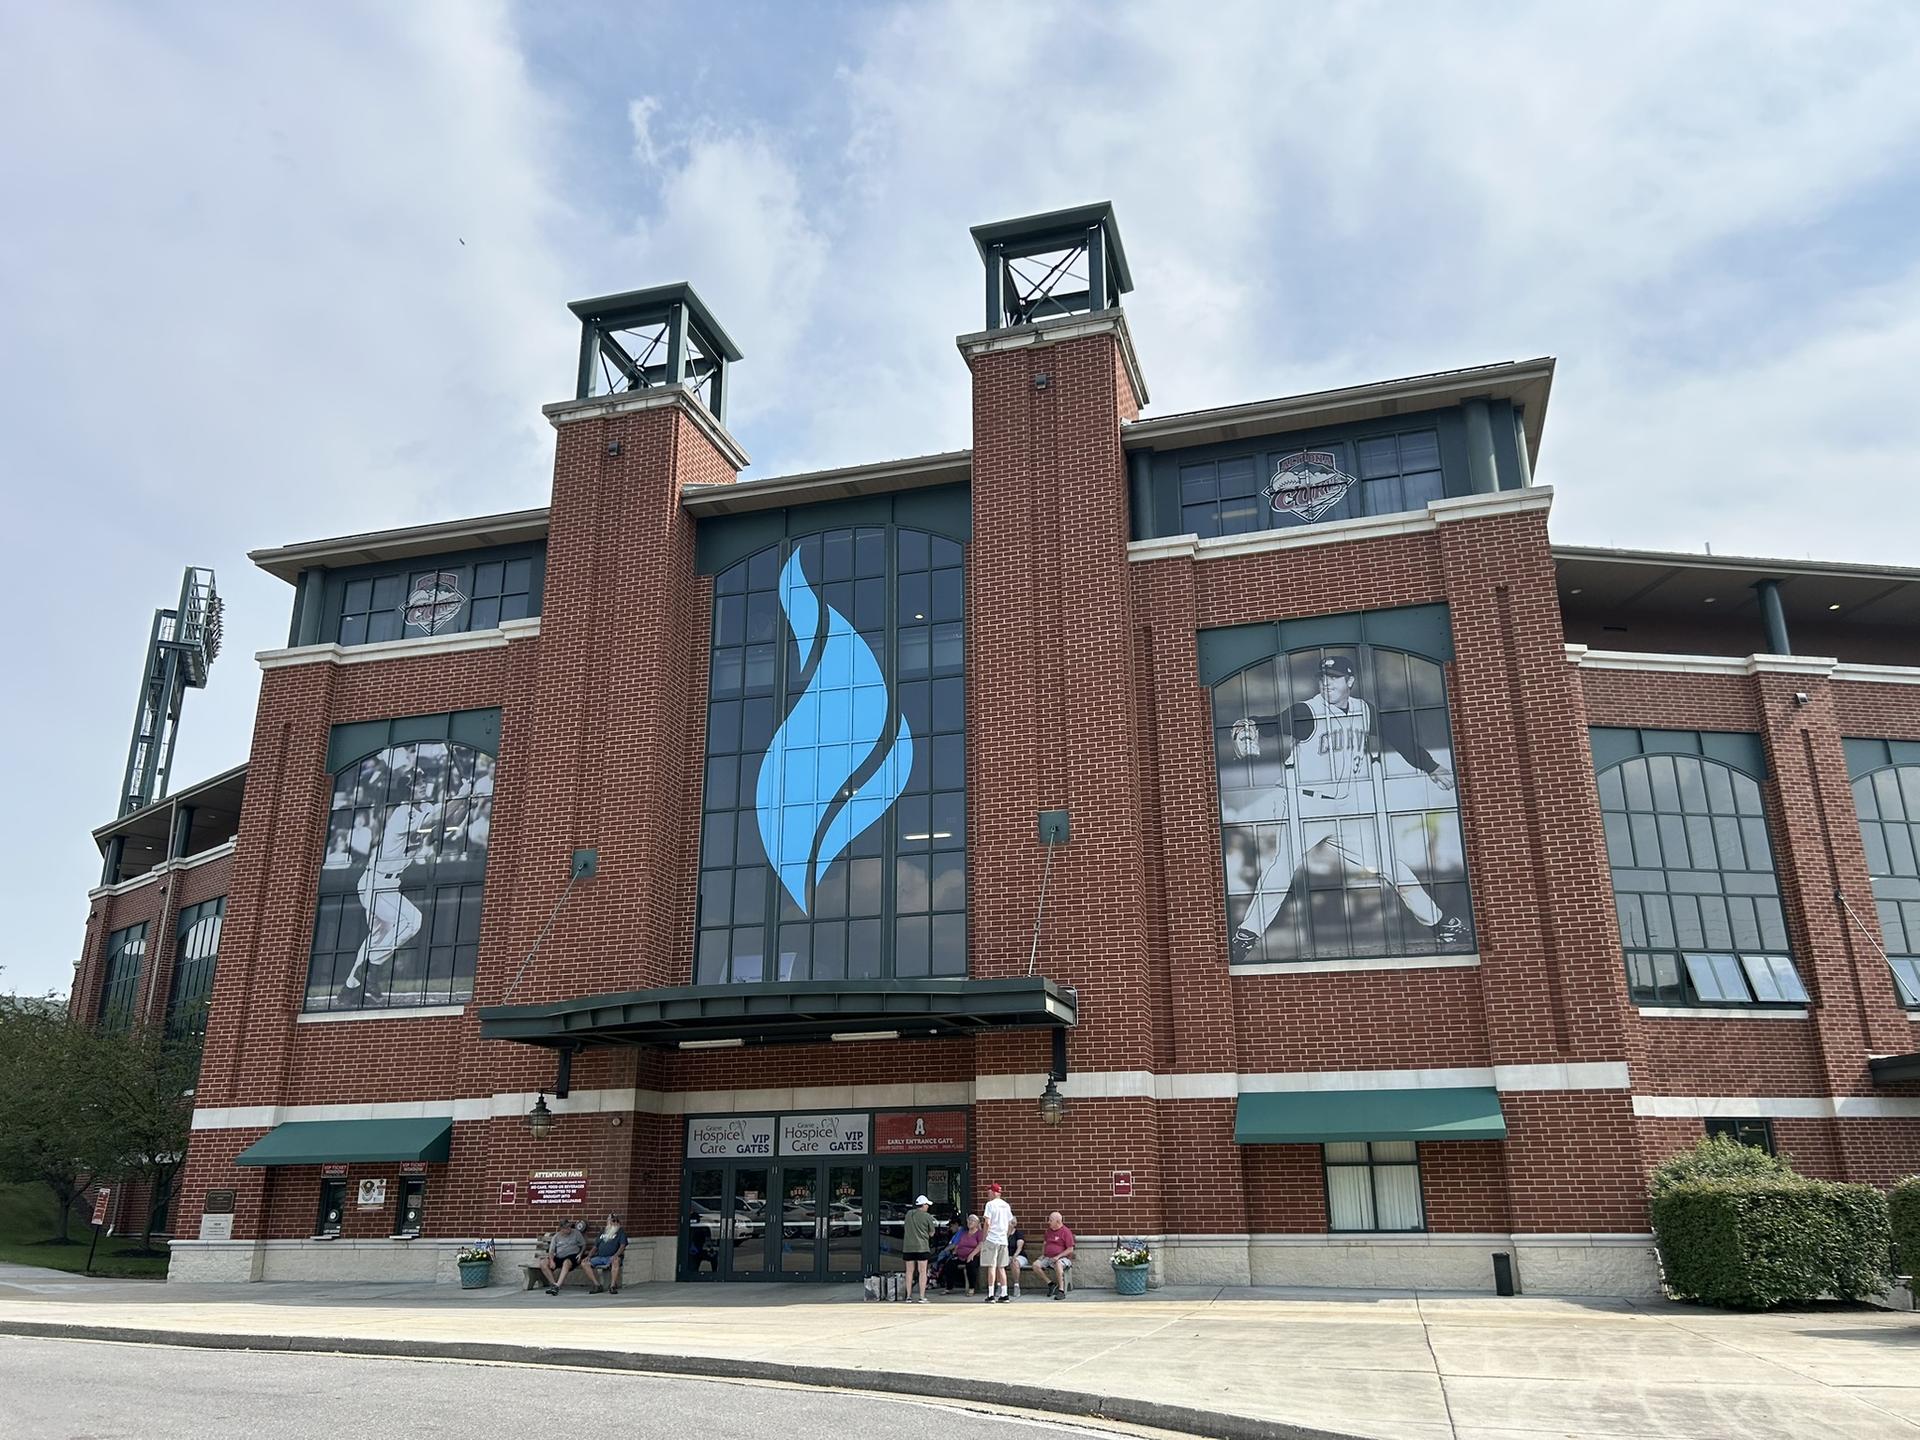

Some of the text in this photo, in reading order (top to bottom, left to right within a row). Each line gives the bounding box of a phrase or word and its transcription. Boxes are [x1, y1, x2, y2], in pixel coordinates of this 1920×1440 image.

[694, 1130, 740, 1143] Hospice
[752, 1134, 770, 1143] VIP
[785, 1127, 833, 1141] Hospice
[845, 1131, 864, 1141] VIP
[700, 1143, 726, 1154] Care
[736, 1144, 769, 1153] GATES
[792, 1140, 819, 1151] Care
[829, 1142, 863, 1151] GATES
